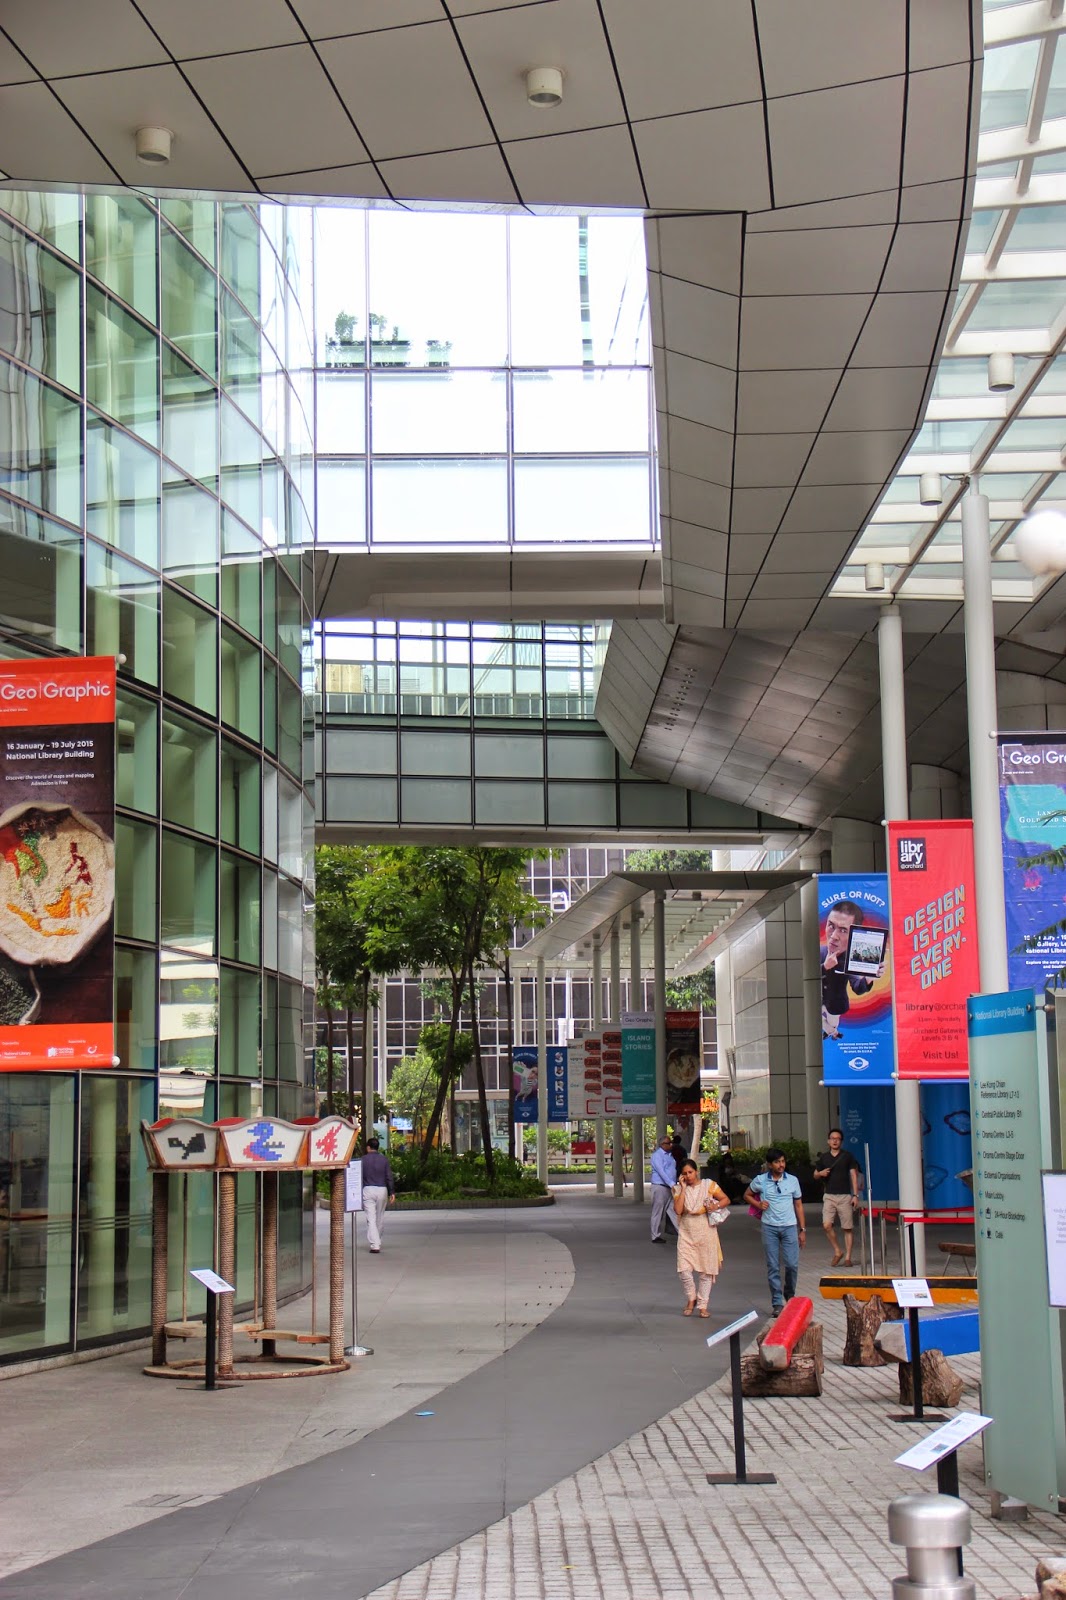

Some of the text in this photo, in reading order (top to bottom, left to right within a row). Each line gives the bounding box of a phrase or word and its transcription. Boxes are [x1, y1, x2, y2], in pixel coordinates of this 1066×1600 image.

[1, 680, 111, 702] Geo Graphic
[64, 750, 94, 758] Building
[1010, 751, 1041, 764] Geo
[849, 890, 862, 898] OR
[864, 892, 886, 907] NOT?
[904, 884, 966, 936] DESIGN
[914, 906, 965, 952] IS FOR
[921, 957, 952, 990] ONE
[974, 1006, 1024, 1020] National Library Building
[944, 1051, 959, 1059] Us!
[998, 1091, 1008, 1099] Library
[1004, 1110, 1015, 1119] Library
[994, 1191, 1004, 1201] Lobby
